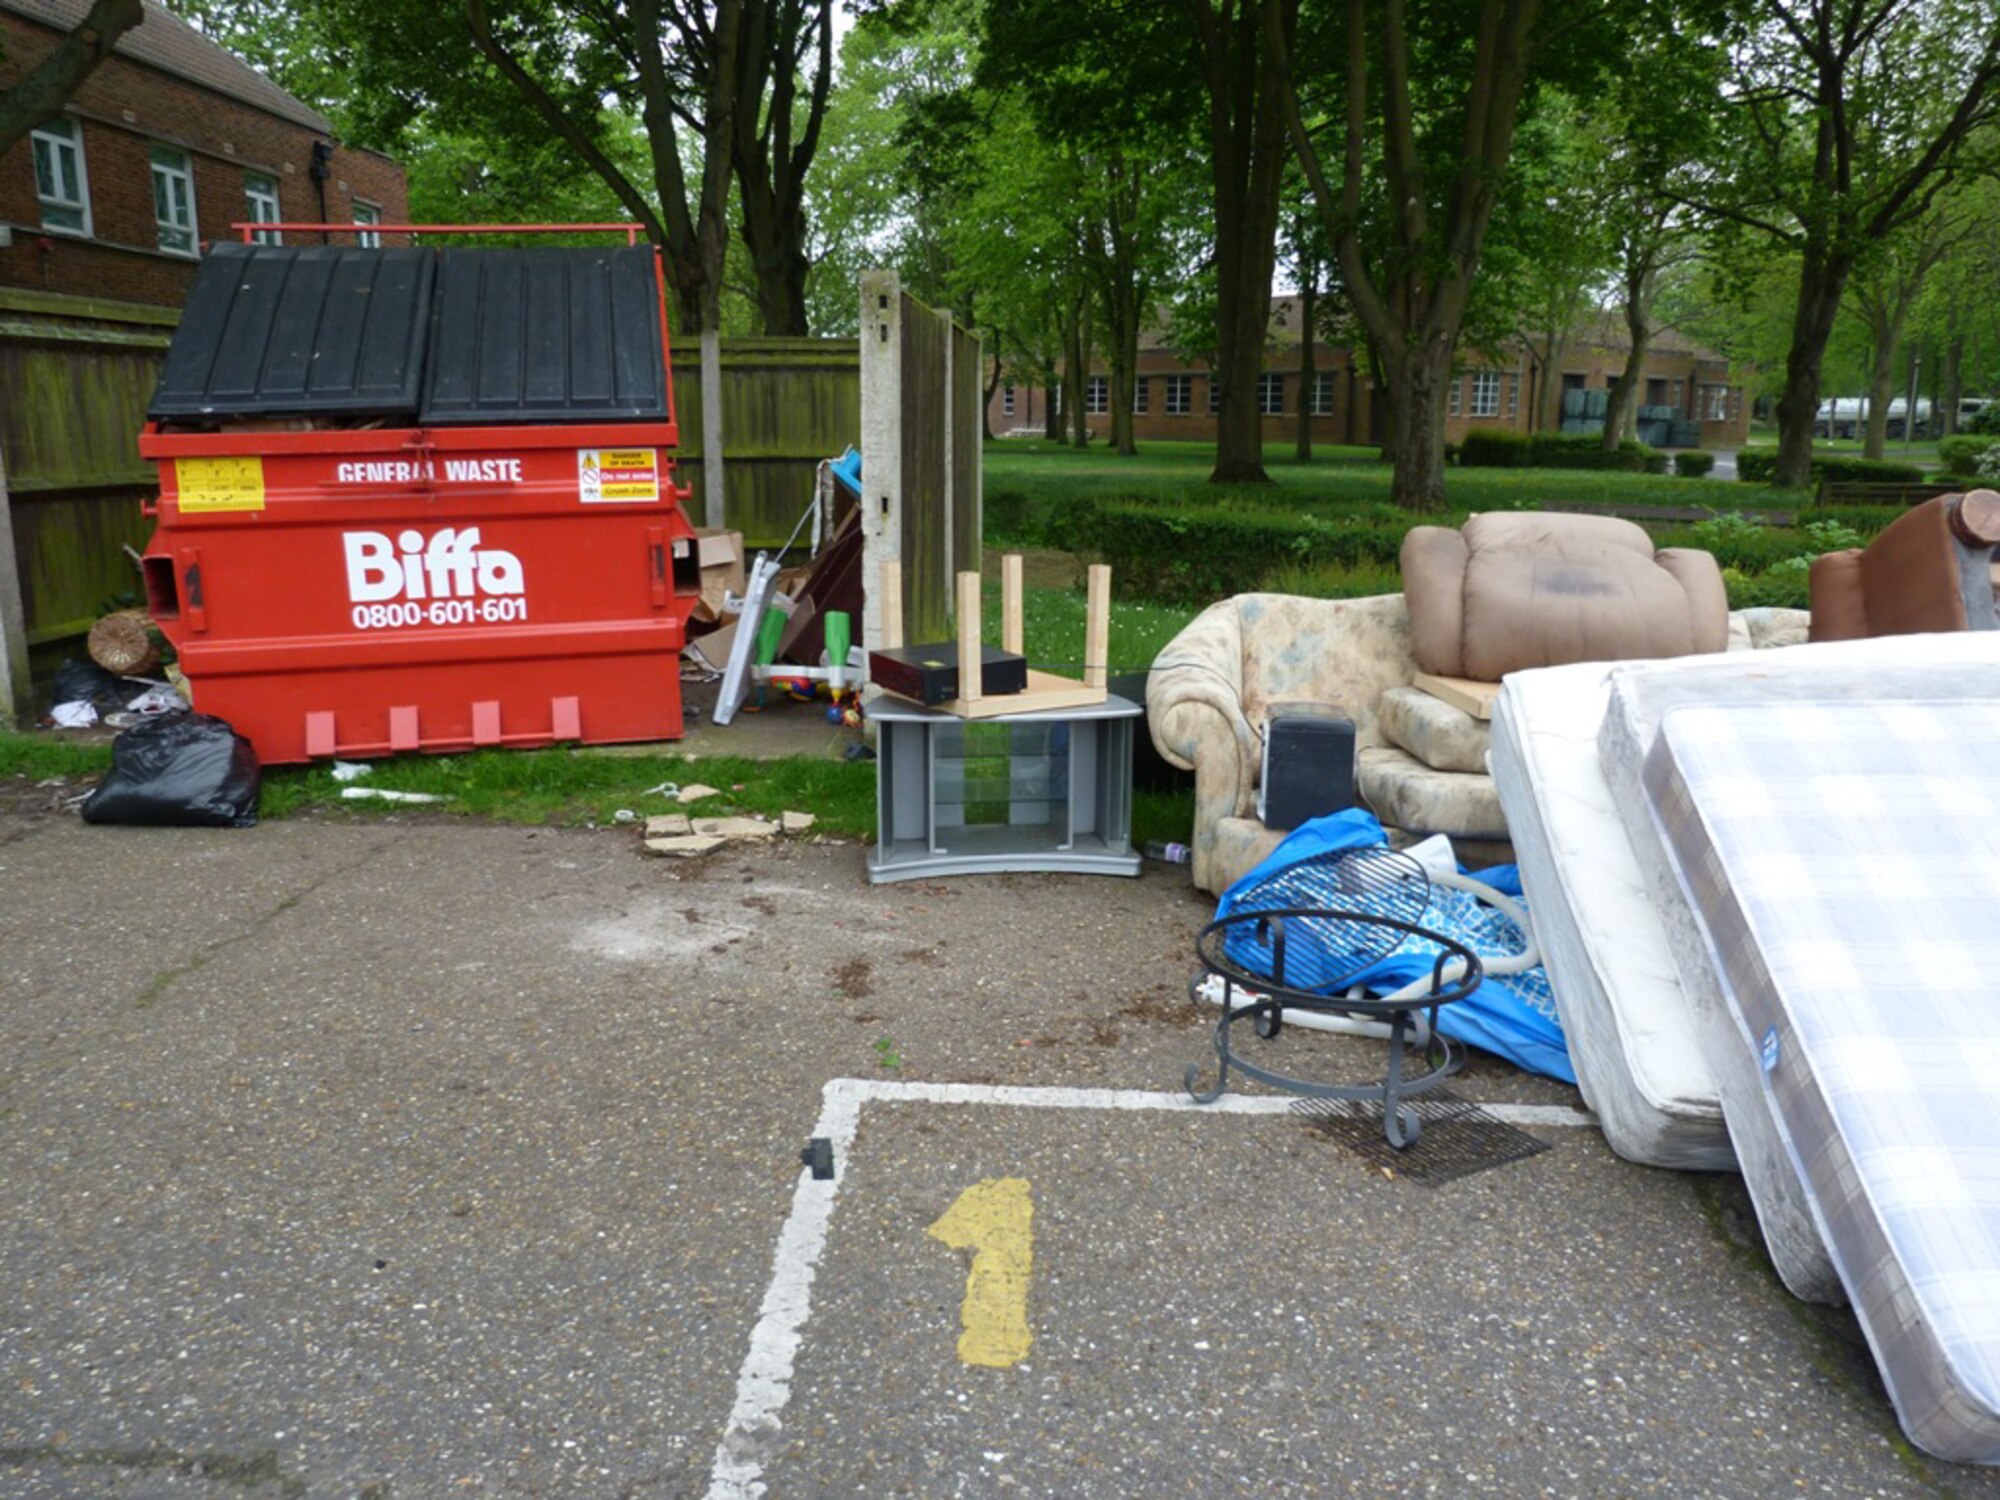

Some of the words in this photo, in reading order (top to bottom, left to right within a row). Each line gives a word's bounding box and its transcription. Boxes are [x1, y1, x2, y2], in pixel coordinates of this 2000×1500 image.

[445, 459, 522, 481] WASTE
[600, 471, 614, 481] Do
[616, 471, 630, 481] not
[632, 471, 654, 481] enter
[605, 487, 629, 495] Crush
[632, 485, 652, 494] Zone
[343, 526, 525, 602] Biffa
[927, 1176, 1034, 1367] 1
